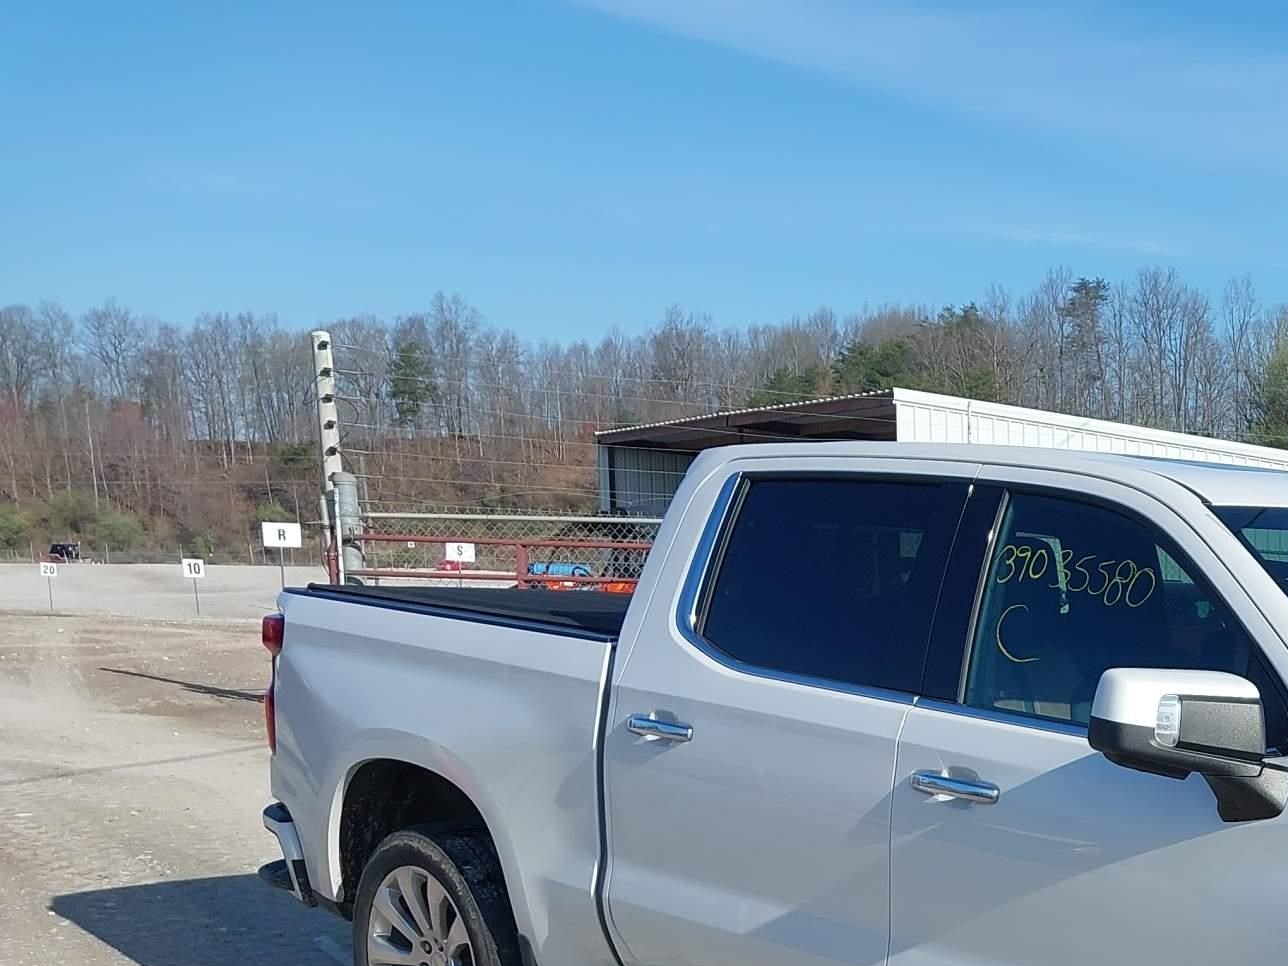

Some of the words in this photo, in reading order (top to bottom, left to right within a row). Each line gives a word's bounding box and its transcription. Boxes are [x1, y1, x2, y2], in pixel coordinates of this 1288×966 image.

[277, 528, 286, 541] R
[456, 545, 463, 556] S
[43, 564, 55, 575] 20
[186, 562, 201, 575] 10
[995, 545, 1155, 608] 39035580
